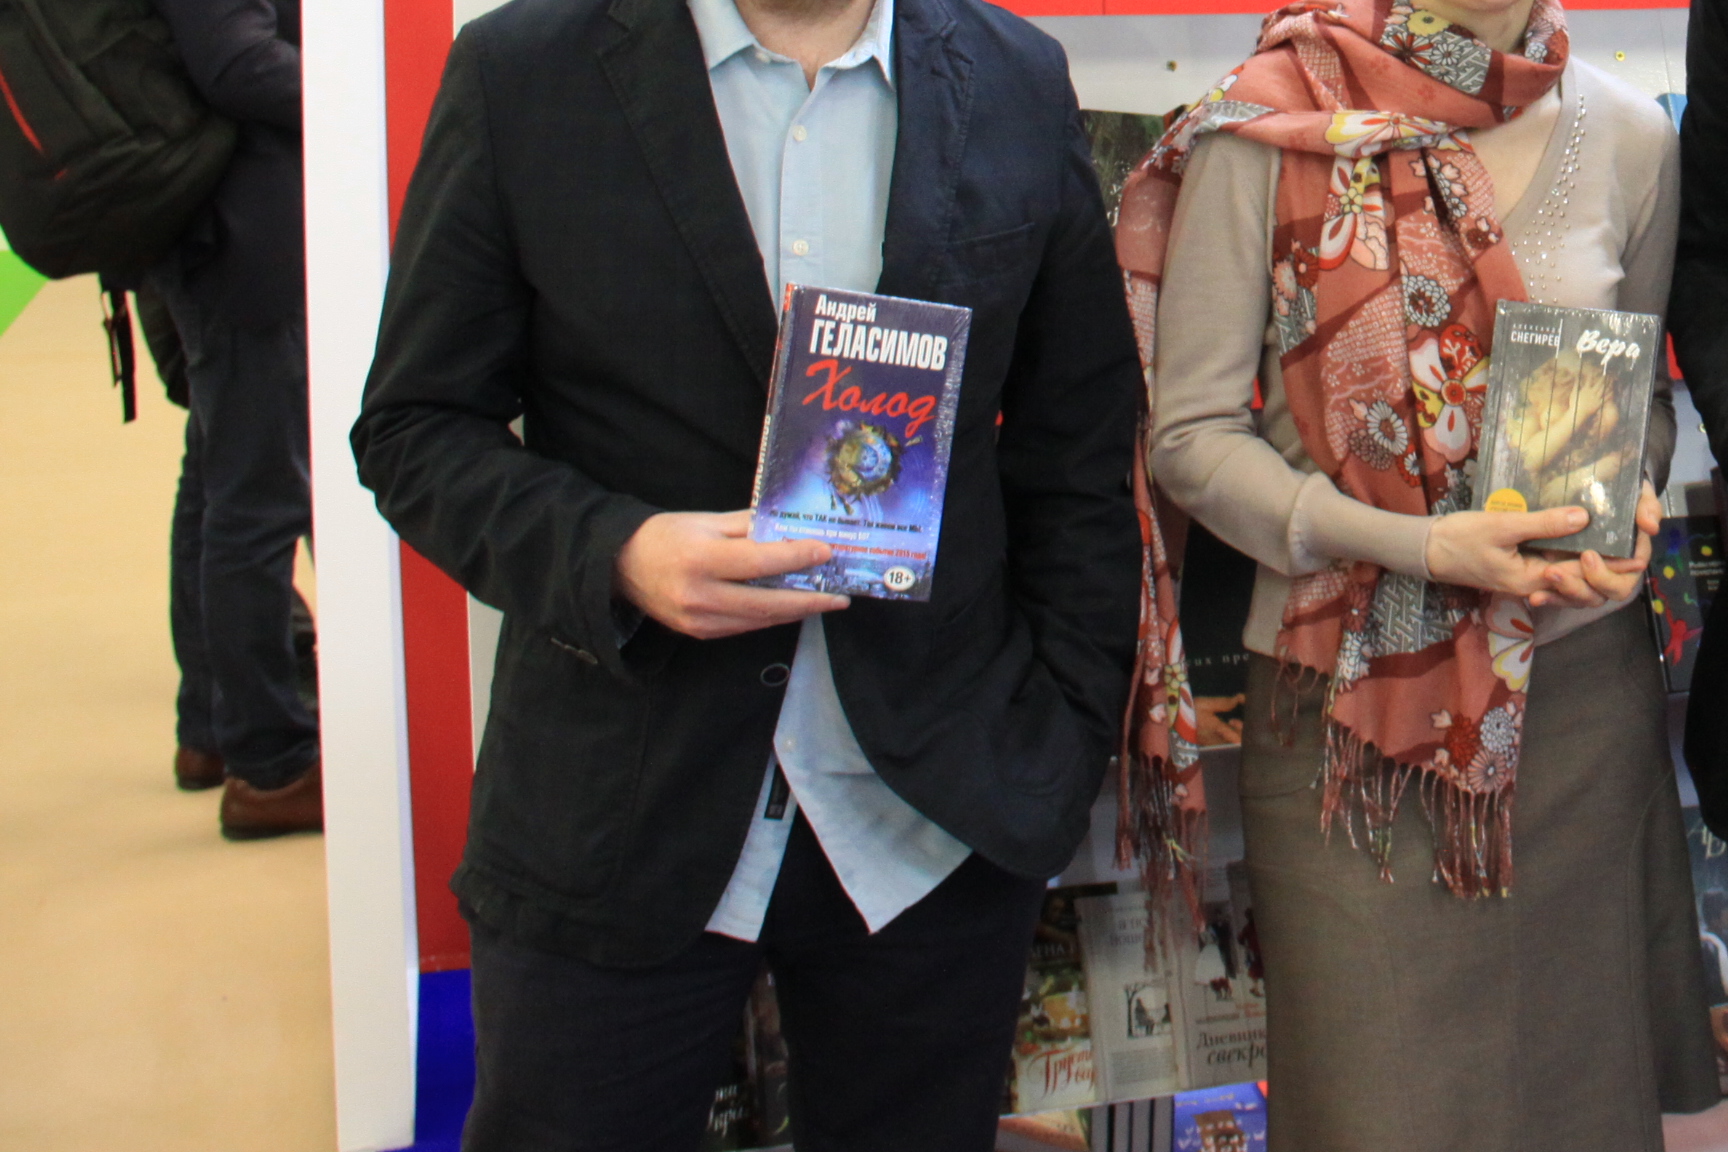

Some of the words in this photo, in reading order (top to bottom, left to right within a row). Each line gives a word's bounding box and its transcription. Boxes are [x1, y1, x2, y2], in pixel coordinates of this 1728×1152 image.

[815, 294, 877, 323] Андрей
[809, 318, 949, 372] ГЕЛАСИМОВ
[1576, 329, 1641, 367] Вера
[802, 358, 938, 439] Холод
[814, 513, 828, 523] ТАК
[887, 570, 912, 584] 18+
